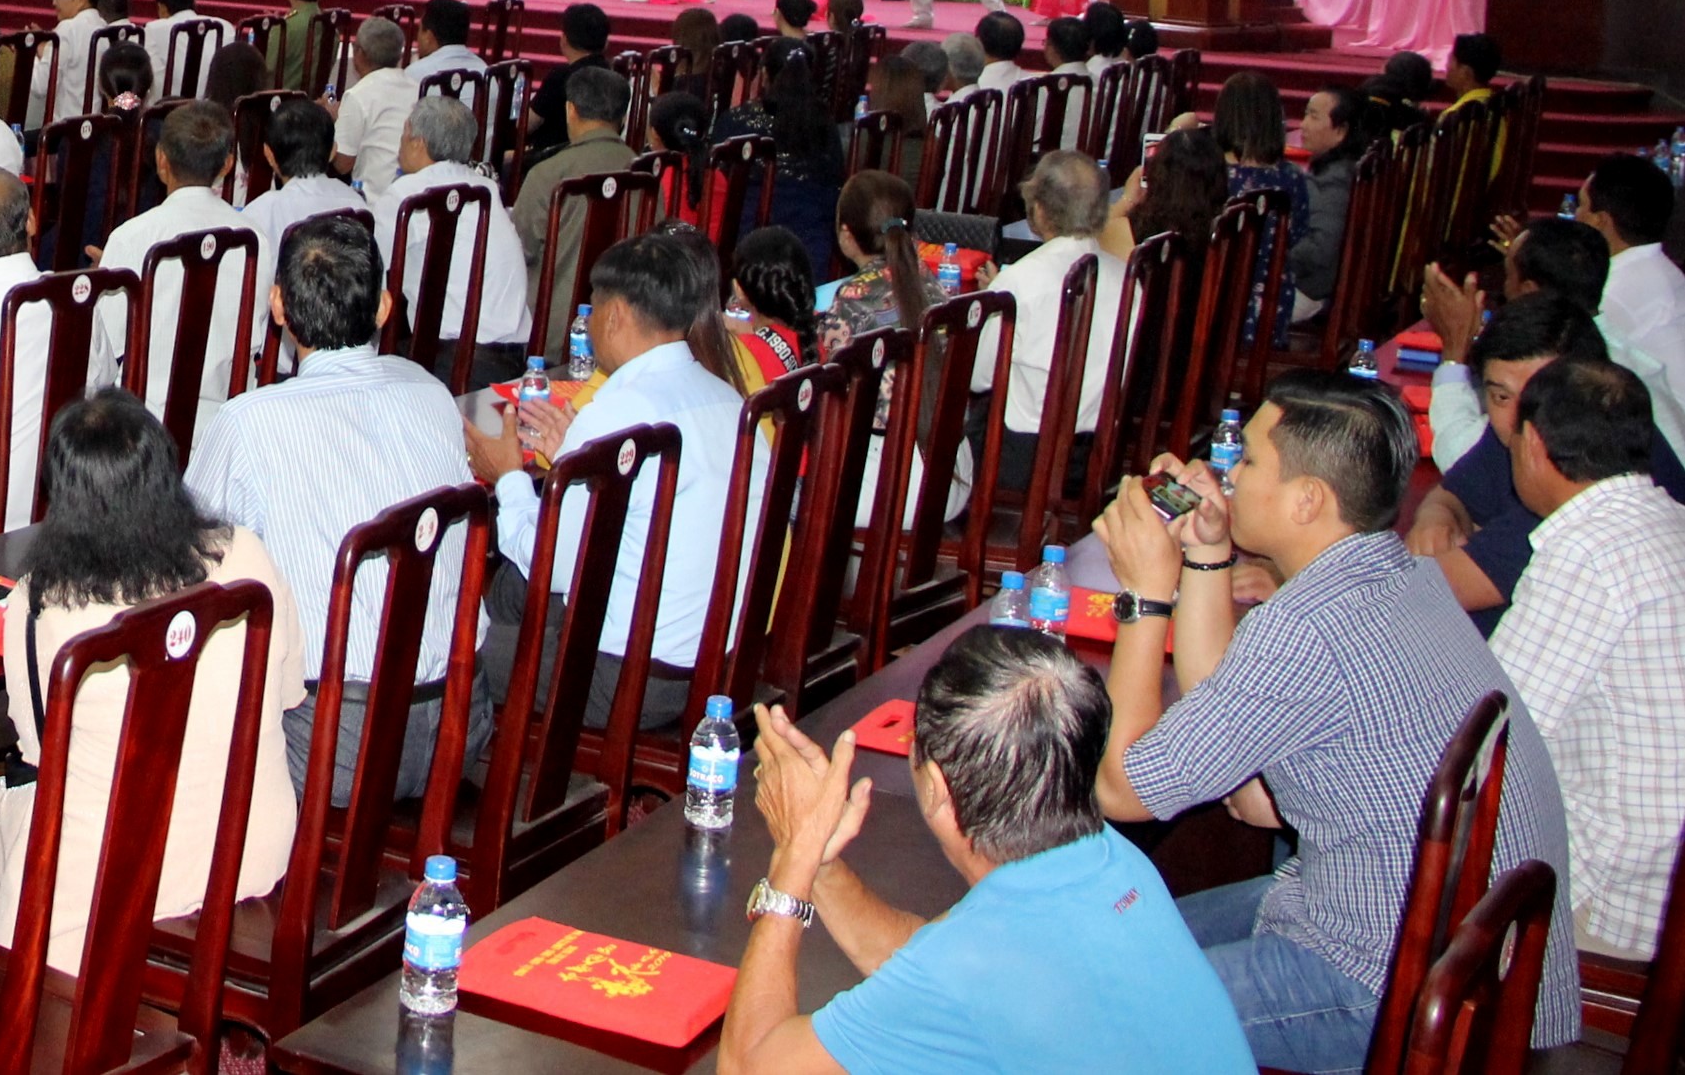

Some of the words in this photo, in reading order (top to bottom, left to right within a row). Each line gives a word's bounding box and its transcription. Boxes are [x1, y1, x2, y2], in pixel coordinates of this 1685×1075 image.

[74, 283, 89, 296] 228
[619, 448, 634, 466] 229
[417, 521, 434, 540] 29
[170, 624, 192, 647] 240
[1113, 886, 1141, 914] TOMMY
